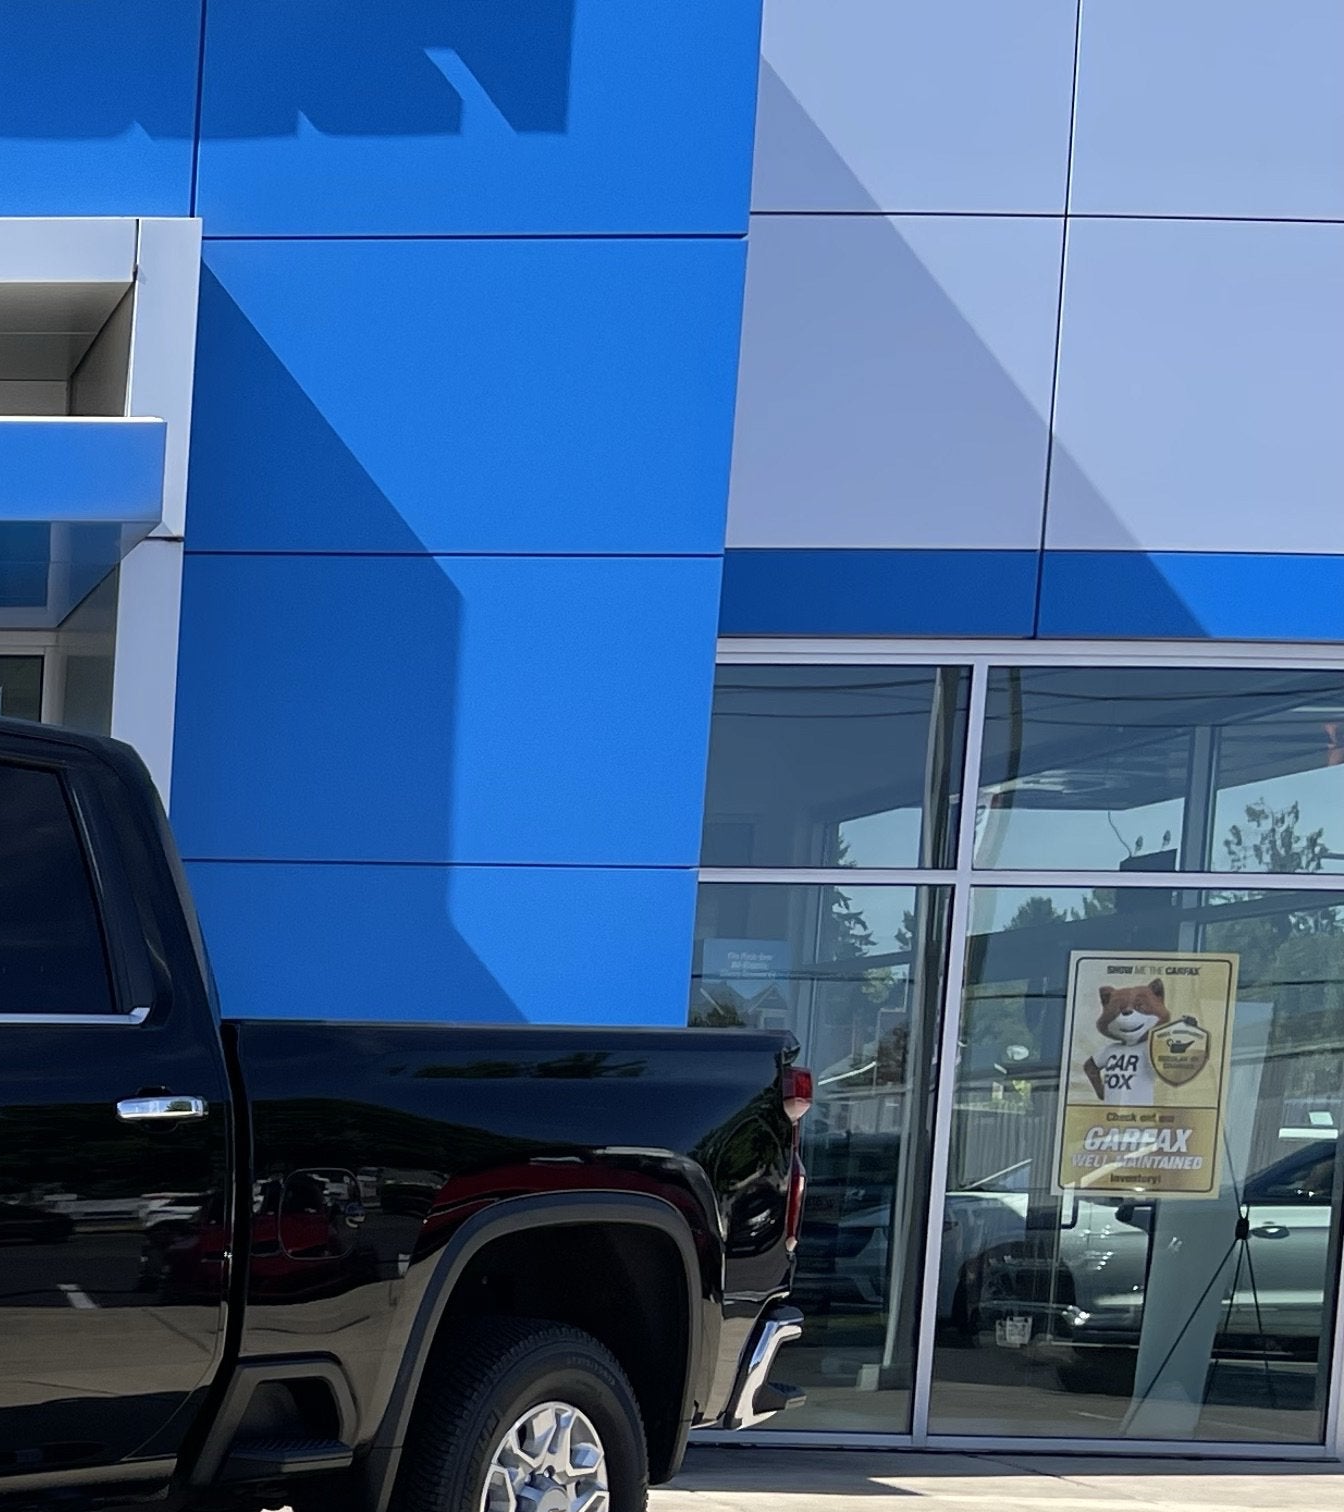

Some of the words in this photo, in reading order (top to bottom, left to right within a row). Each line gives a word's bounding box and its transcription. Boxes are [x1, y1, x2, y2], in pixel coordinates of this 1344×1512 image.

[1165, 967, 1201, 976] CARFAX
[1105, 1054, 1139, 1073] CAR
[1107, 1112, 1137, 1122] Check
[1084, 1126, 1193, 1153] CARFAX
[1072, 1152, 1108, 1168] WELL
[1116, 1154, 1203, 1170] MAINTAINED
